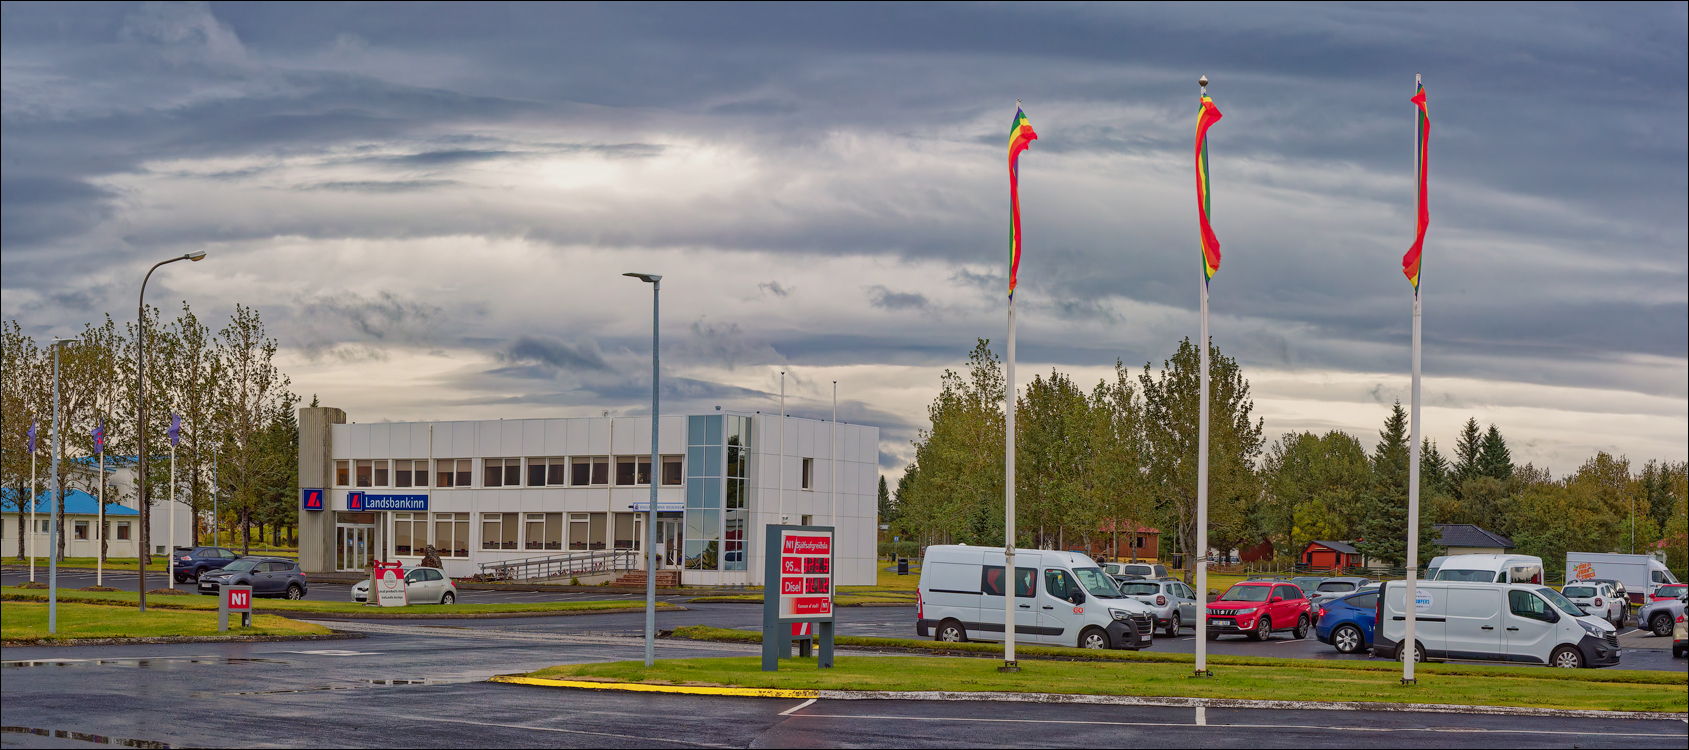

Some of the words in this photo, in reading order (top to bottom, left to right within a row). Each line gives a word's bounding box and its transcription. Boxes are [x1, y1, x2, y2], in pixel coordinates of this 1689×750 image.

[365, 497, 424, 508] Landsbankinn
[786, 540, 794, 549] N1
[785, 561, 794, 572] 95
[804, 557, 829, 573] 326.9
[785, 581, 801, 592] Dísel
[231, 593, 246, 605] N1
